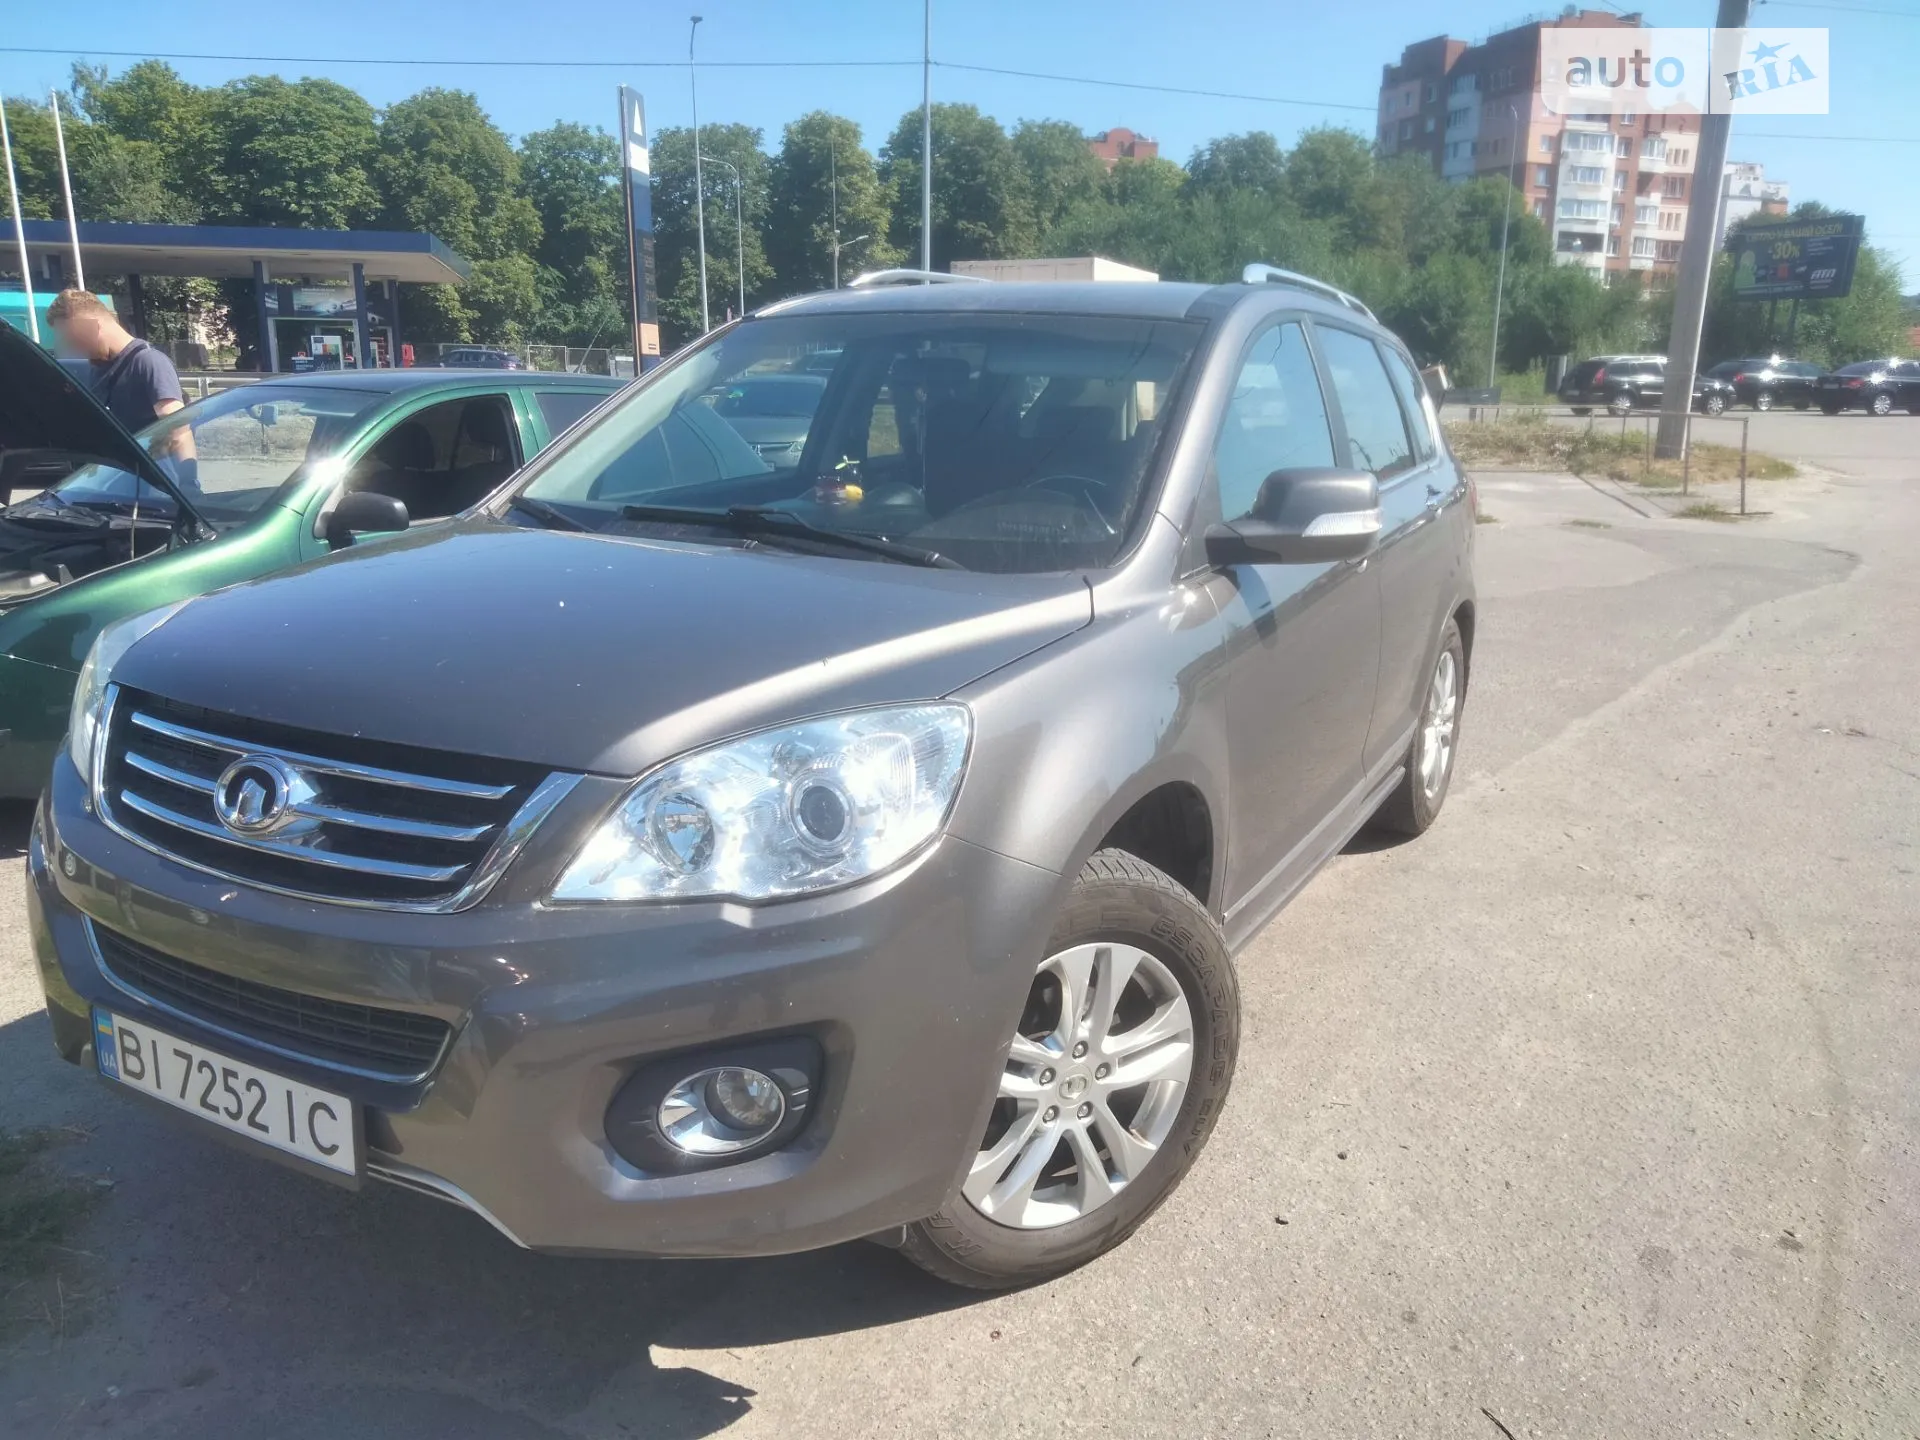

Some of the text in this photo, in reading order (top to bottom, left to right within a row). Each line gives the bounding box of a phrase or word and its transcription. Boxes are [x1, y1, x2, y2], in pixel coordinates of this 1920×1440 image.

[101, 1050, 118, 1071] UA
[117, 1026, 340, 1156] BI 7252 IC
